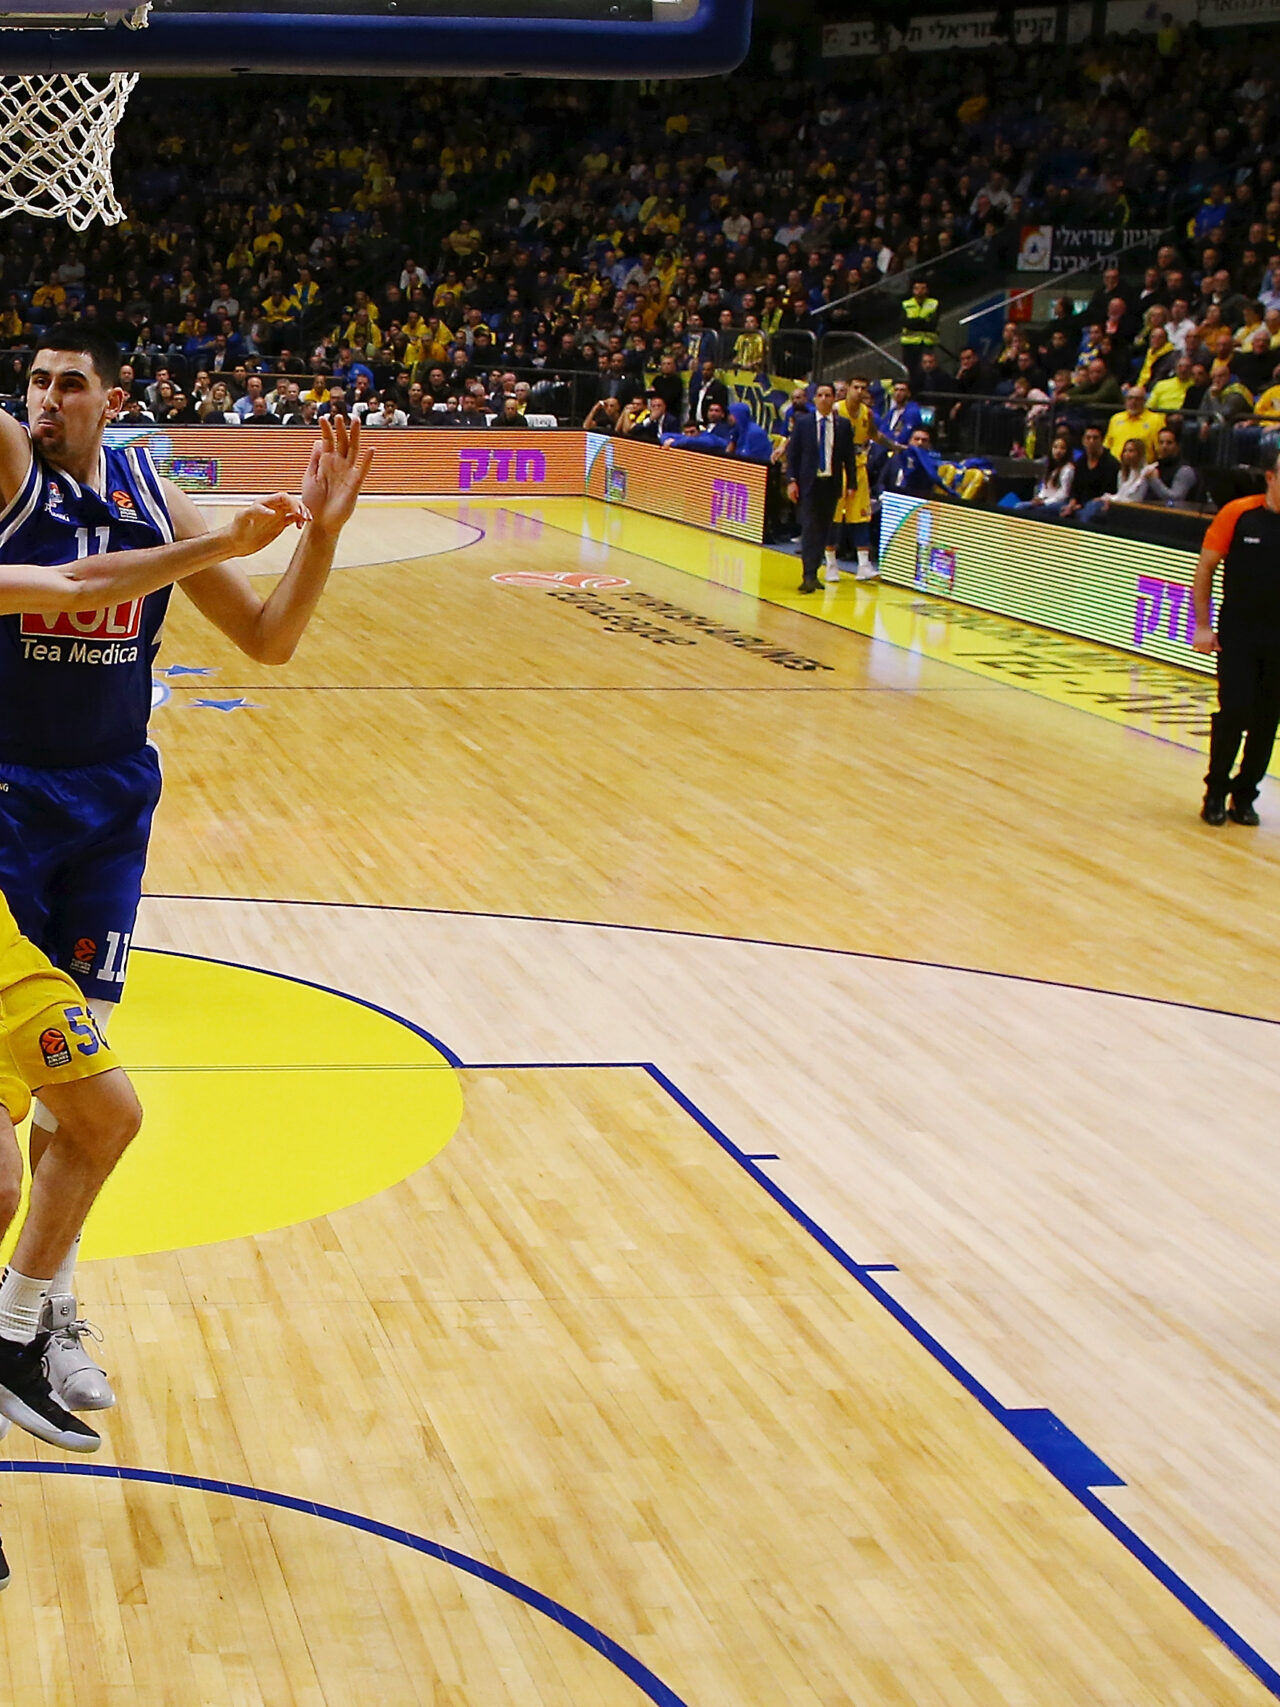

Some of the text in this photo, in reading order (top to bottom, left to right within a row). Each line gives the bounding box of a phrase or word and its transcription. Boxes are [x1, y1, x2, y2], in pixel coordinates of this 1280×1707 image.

[20, 638, 138, 665] Tea Medica
[64, 1006, 110, 1056] 5
